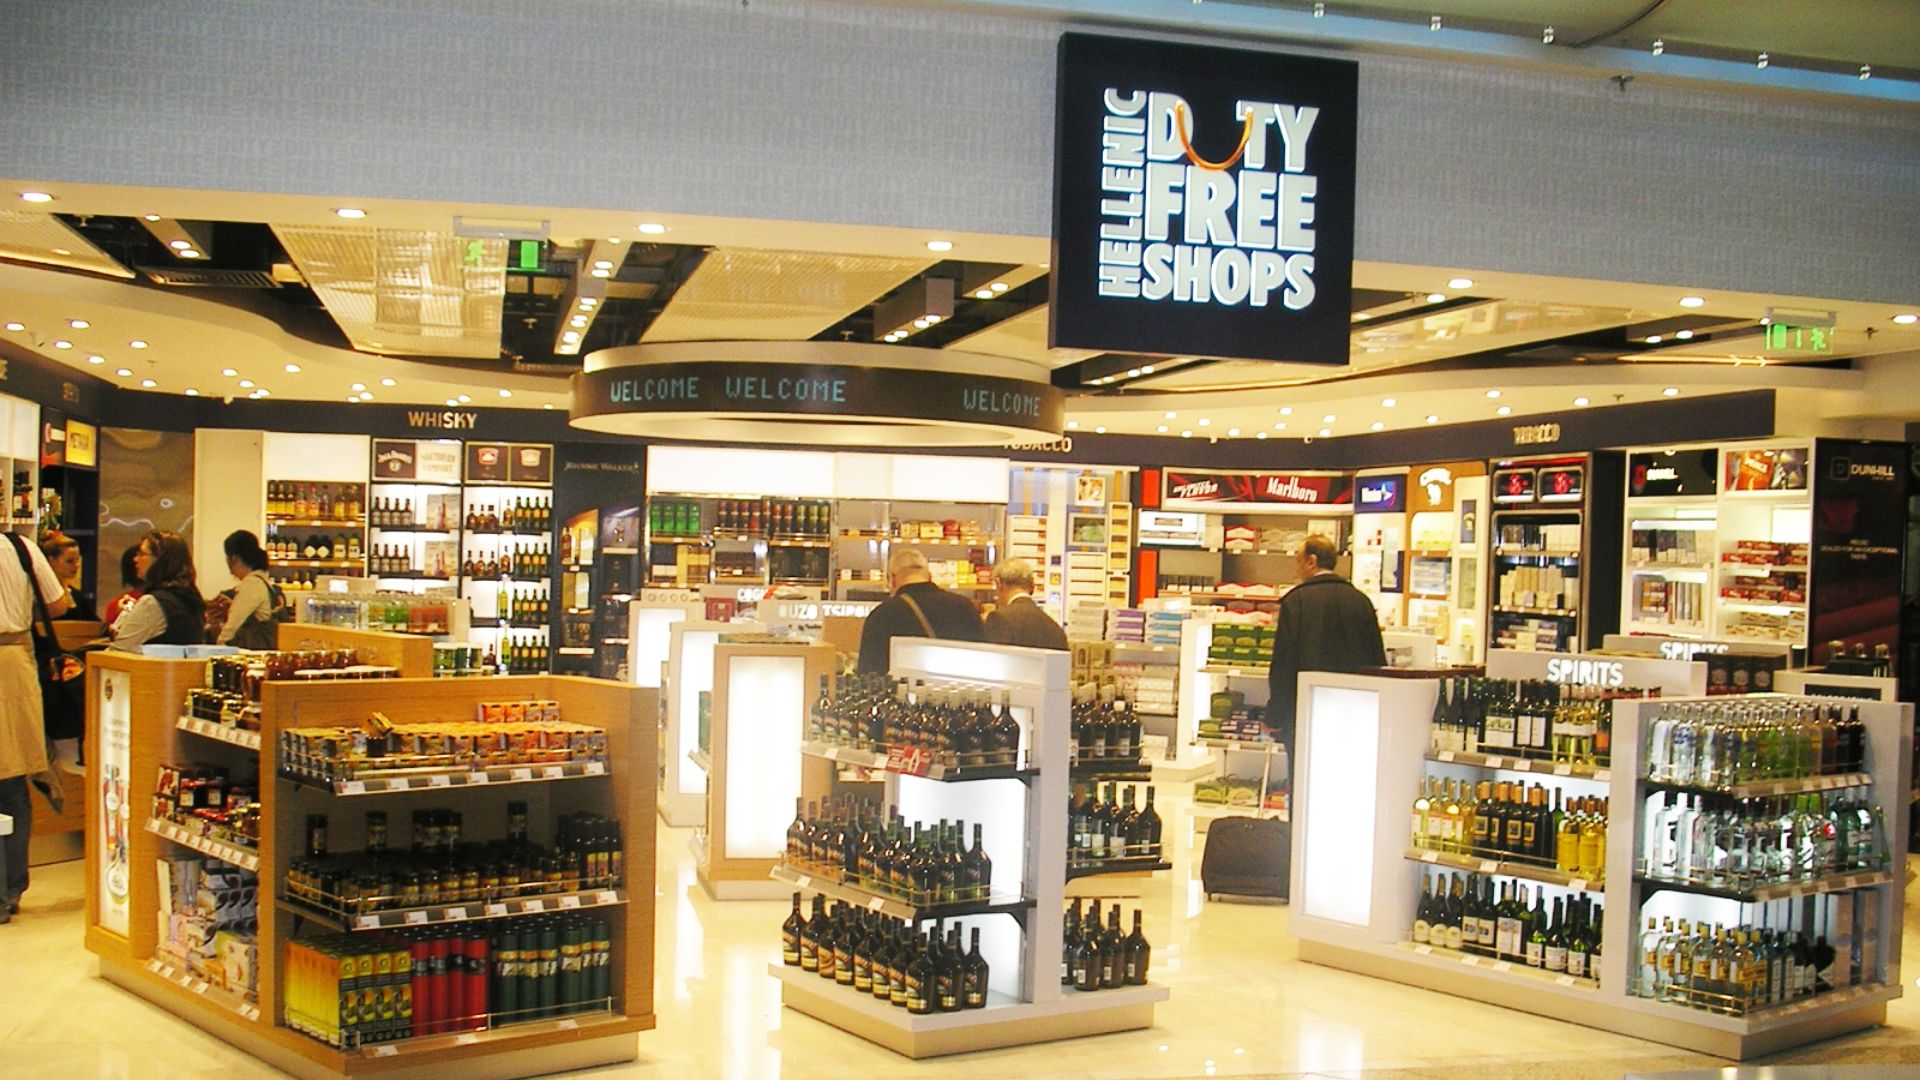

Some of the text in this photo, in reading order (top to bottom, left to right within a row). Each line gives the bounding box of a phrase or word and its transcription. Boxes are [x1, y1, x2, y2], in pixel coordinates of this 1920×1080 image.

[1099, 87, 1147, 298] HELLENIC
[1144, 161, 1318, 252] FREE
[1141, 243, 1316, 310] SHOPS
[611, 376, 1041, 417] WELCOME WELCOME WELCOME
[407, 411, 477, 430] WHISKY
[1513, 423, 1561, 445] TOBACCO
[1850, 463, 1896, 476] DUNHILL
[1266, 476, 1318, 503] Marlboro
[1547, 658, 1624, 687] SPIRITS
